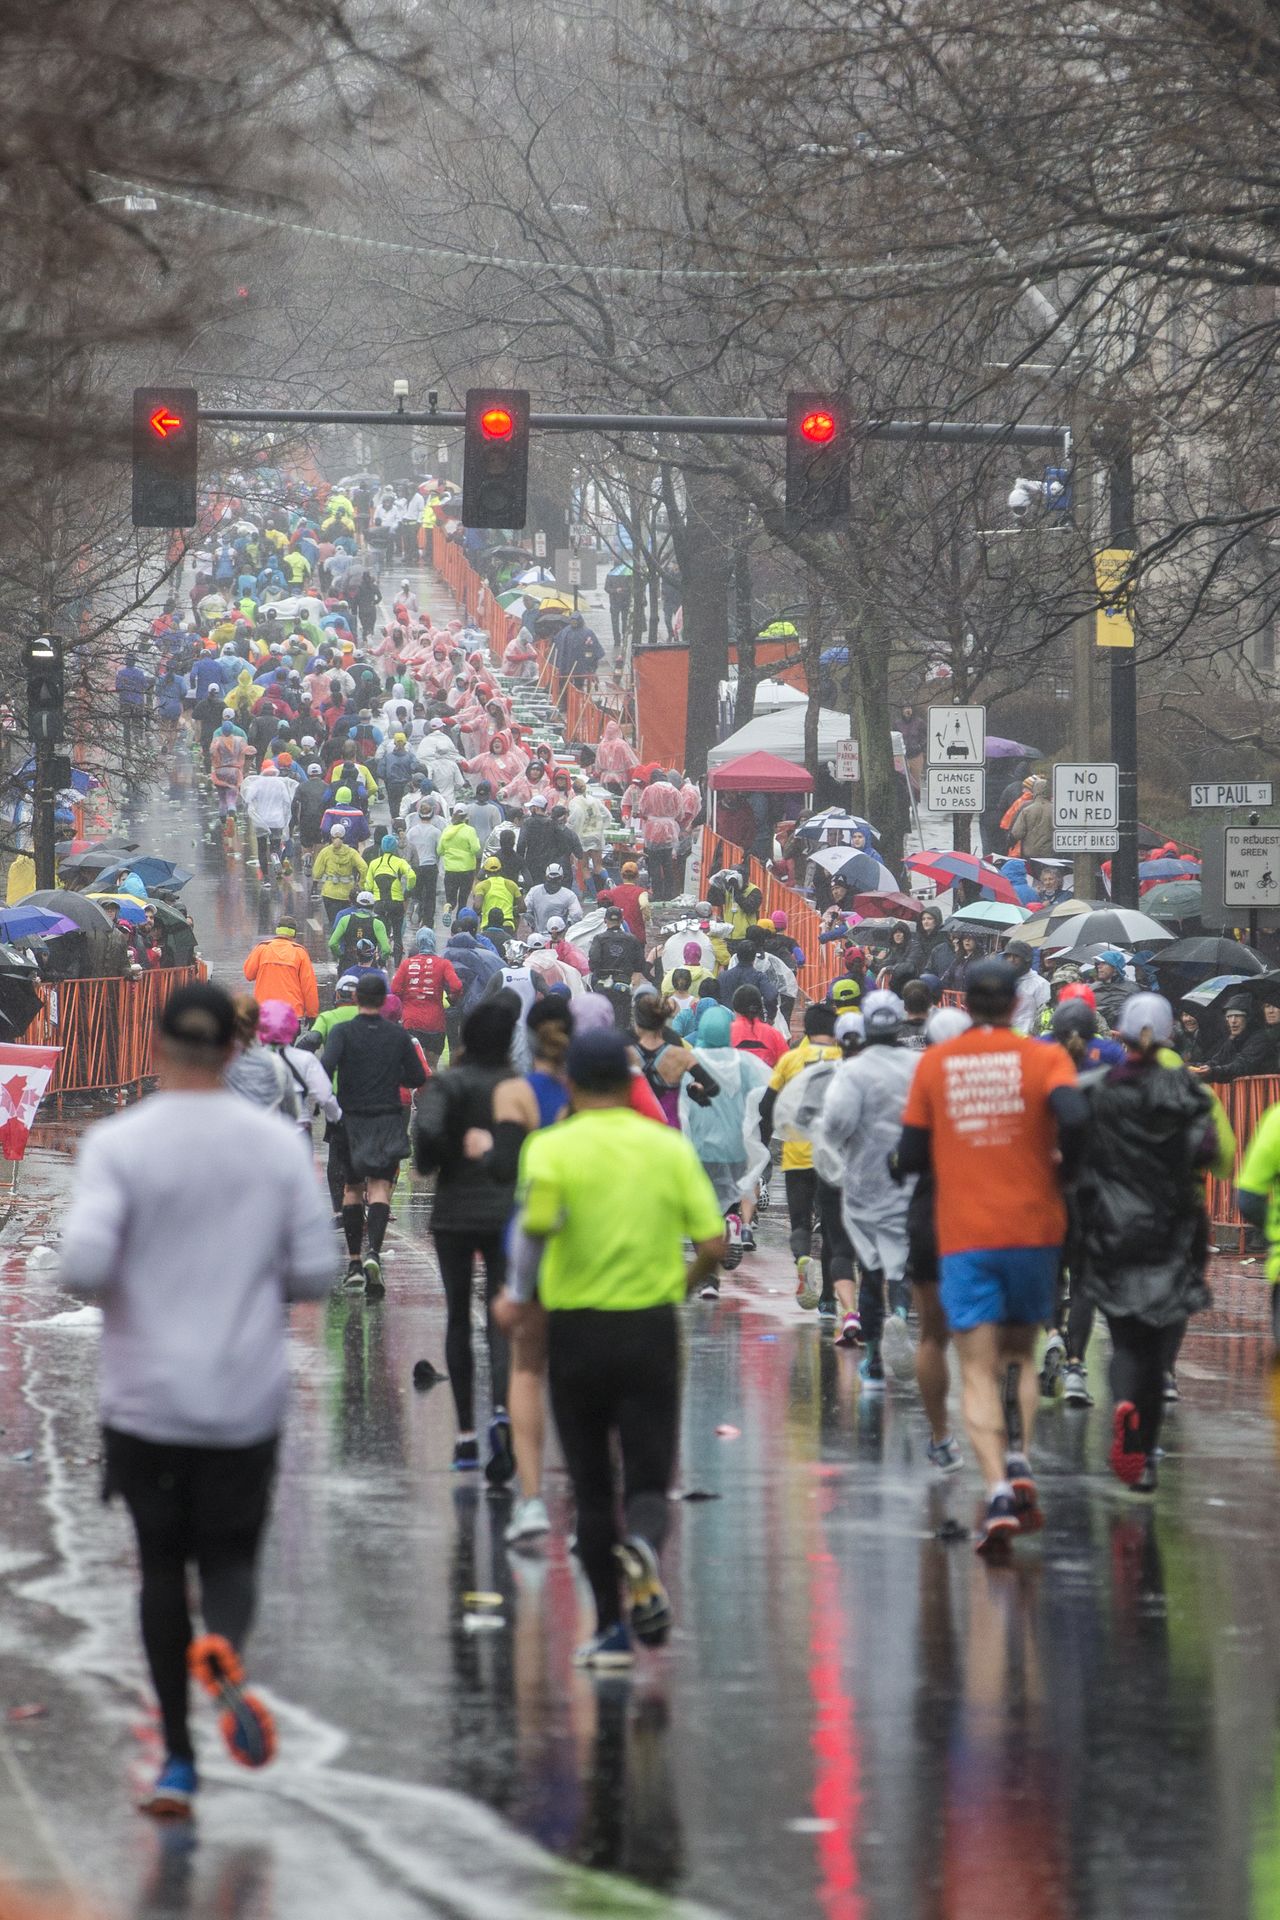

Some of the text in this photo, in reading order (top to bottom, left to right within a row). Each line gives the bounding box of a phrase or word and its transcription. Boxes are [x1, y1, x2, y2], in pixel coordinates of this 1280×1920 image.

[843, 743, 853, 752] NO
[836, 752, 859, 760] PARKING
[937, 773, 975, 782] CHANGE
[1074, 772, 1098, 784] NO
[941, 786, 971, 794] LANES
[1194, 785, 1268, 804] ST PAUL ST
[1067, 790, 1104, 802] TURN
[936, 798, 976, 807] TO PASS
[1059, 808, 1112, 820] ON RED
[1056, 835, 1116, 846] EXCEPT BIKES
[1229, 835, 1279, 845] TO REQUEST
[1241, 848, 1269, 856] GREEN
[1230, 869, 1249, 878] WAIT
[943, 1051, 1021, 1069] IMAGINE
[962, 1067, 1022, 1083] WORLD
[948, 1084, 1022, 1101] WITHOUT
[947, 1099, 1025, 1117] CANCER
